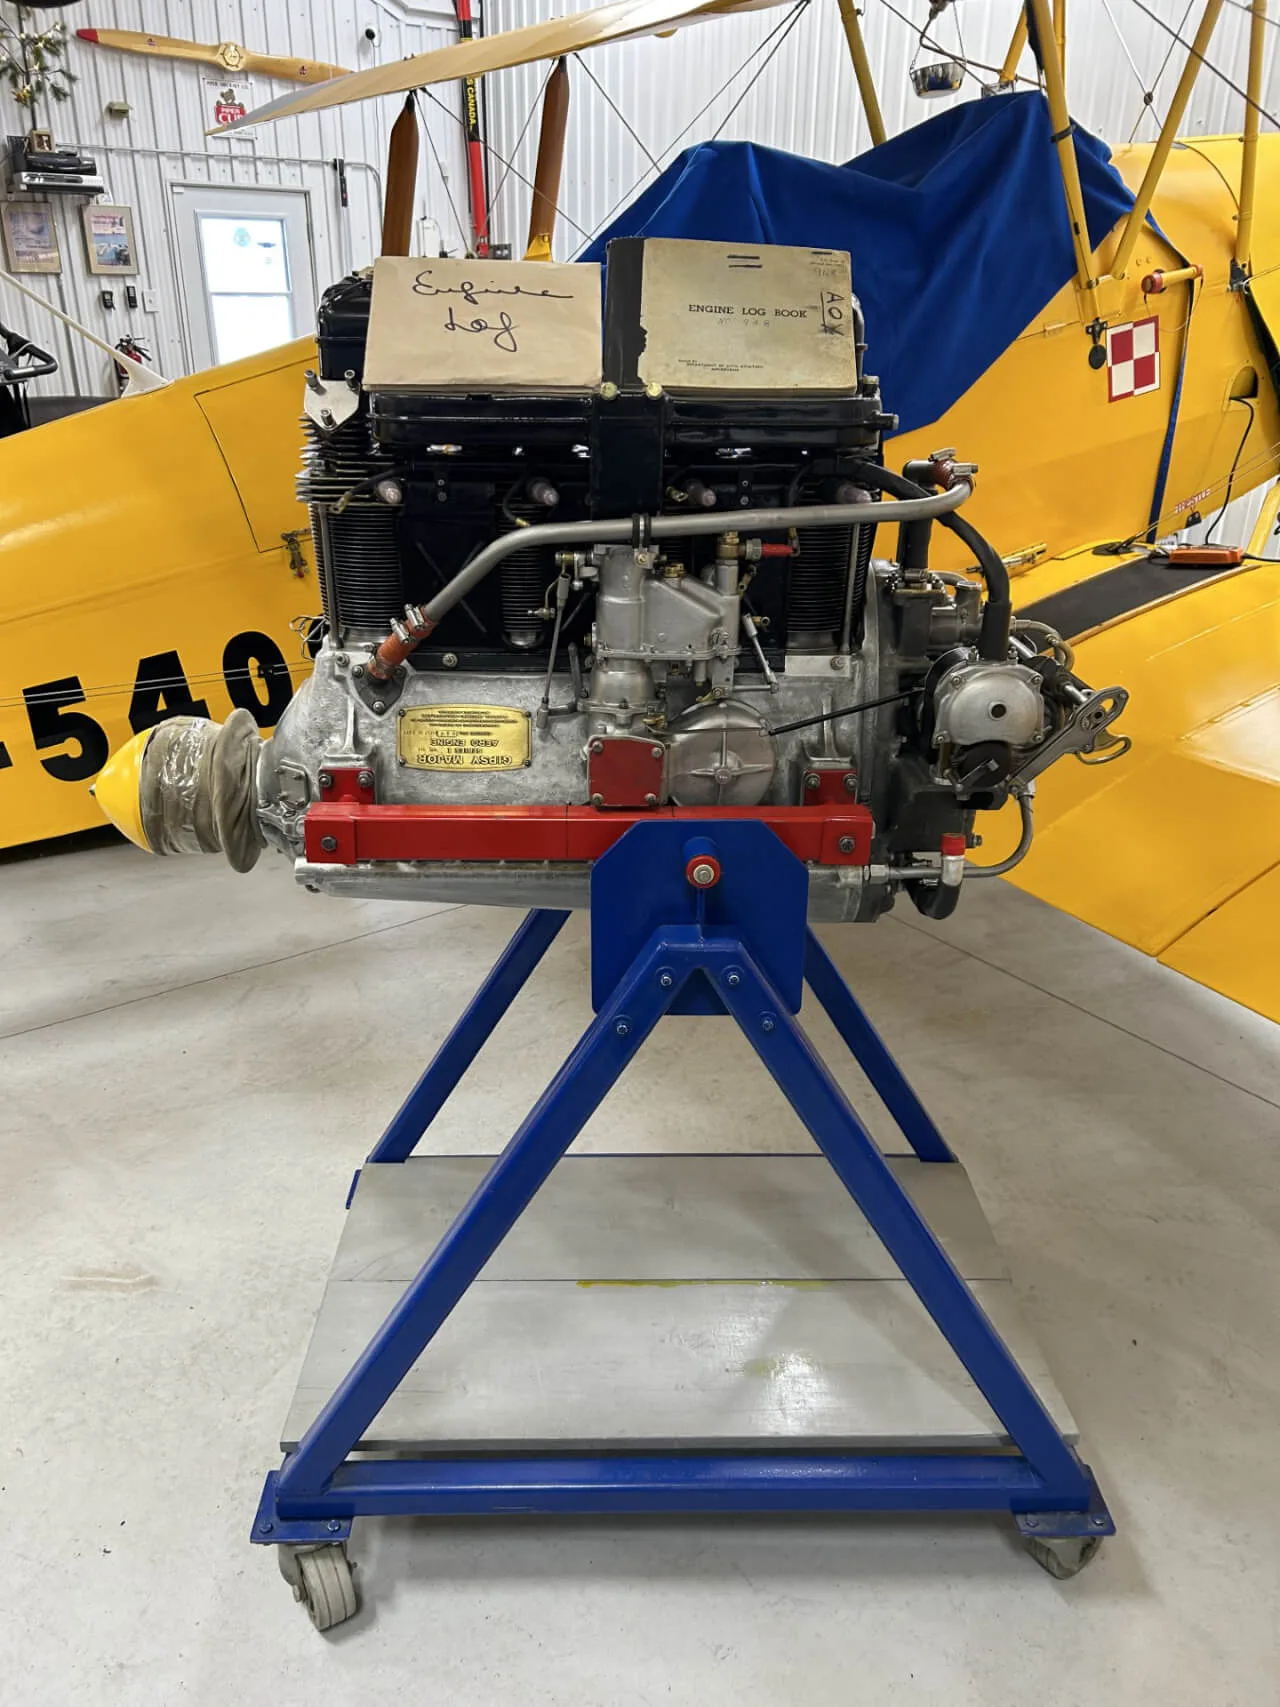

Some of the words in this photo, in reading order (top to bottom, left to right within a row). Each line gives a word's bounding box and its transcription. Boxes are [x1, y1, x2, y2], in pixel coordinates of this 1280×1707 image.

[688, 304, 734, 314] ENGINE
[742, 307, 766, 316] LOG
[774, 308, 808, 318] BOOK
[431, 739, 466, 747] ENGINE
[417, 754, 464, 765] MAJOR
[471, 755, 512, 765] GIPSY
